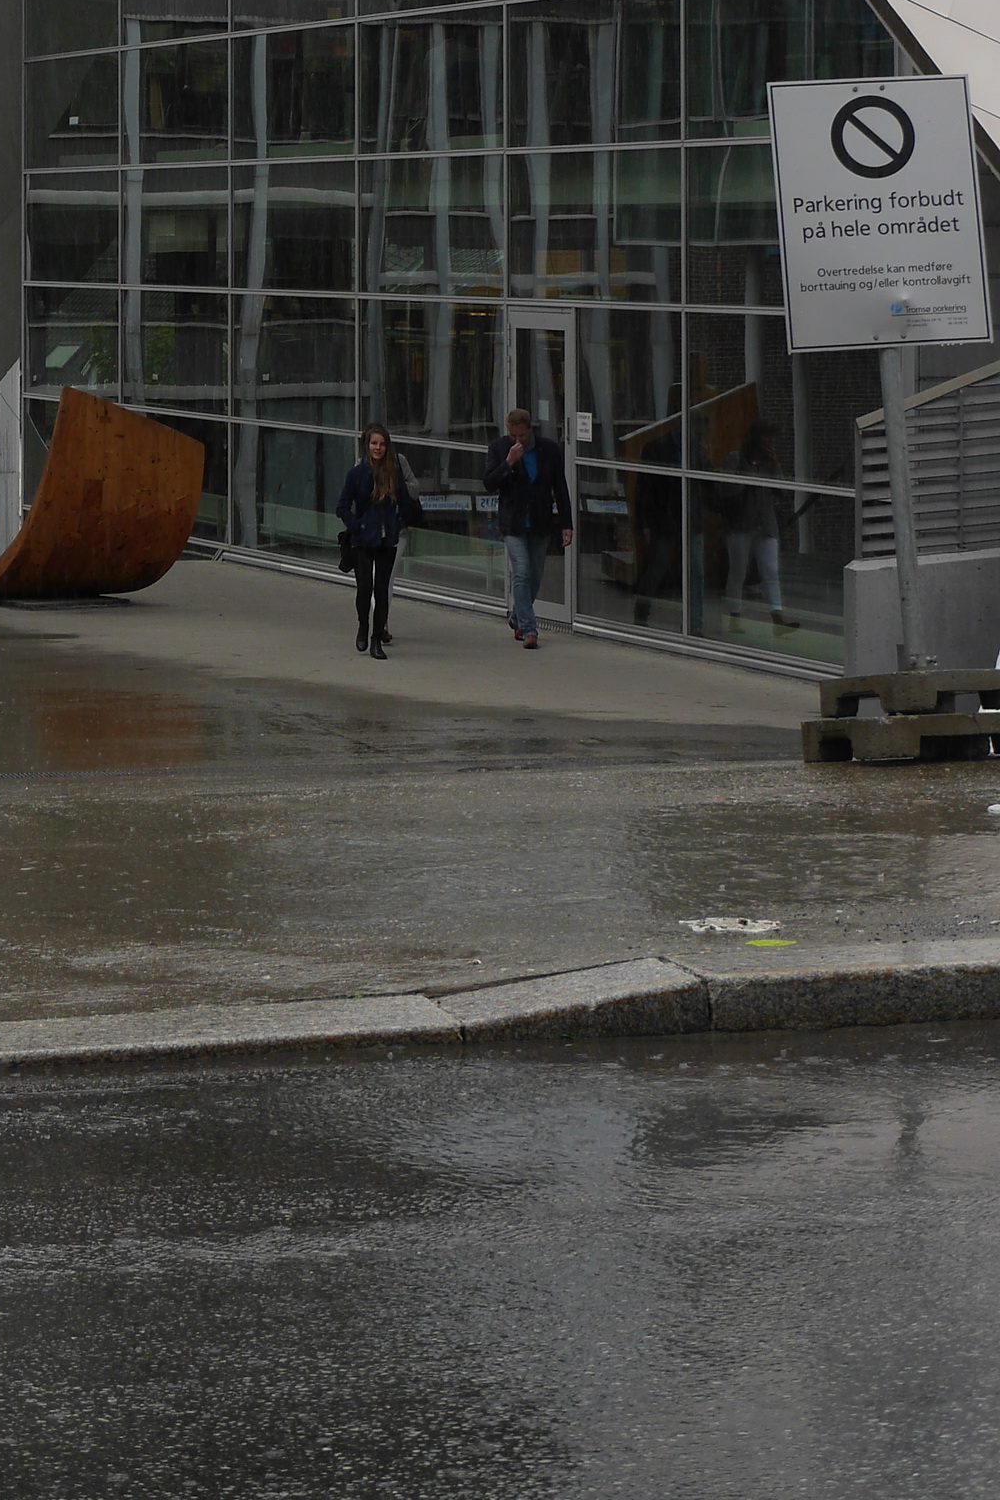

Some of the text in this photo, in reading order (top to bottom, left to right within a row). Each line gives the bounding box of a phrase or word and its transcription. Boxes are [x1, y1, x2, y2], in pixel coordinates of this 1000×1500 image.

[793, 189, 964, 213] Parkering forbudt
[802, 216, 960, 243] på hele området
[817, 261, 953, 277] Overtredelse kan medføre
[800, 279, 856, 292] borttauing
[902, 274, 971, 287] kontrollavgift
[905, 303, 967, 314] Tromsø parkering
